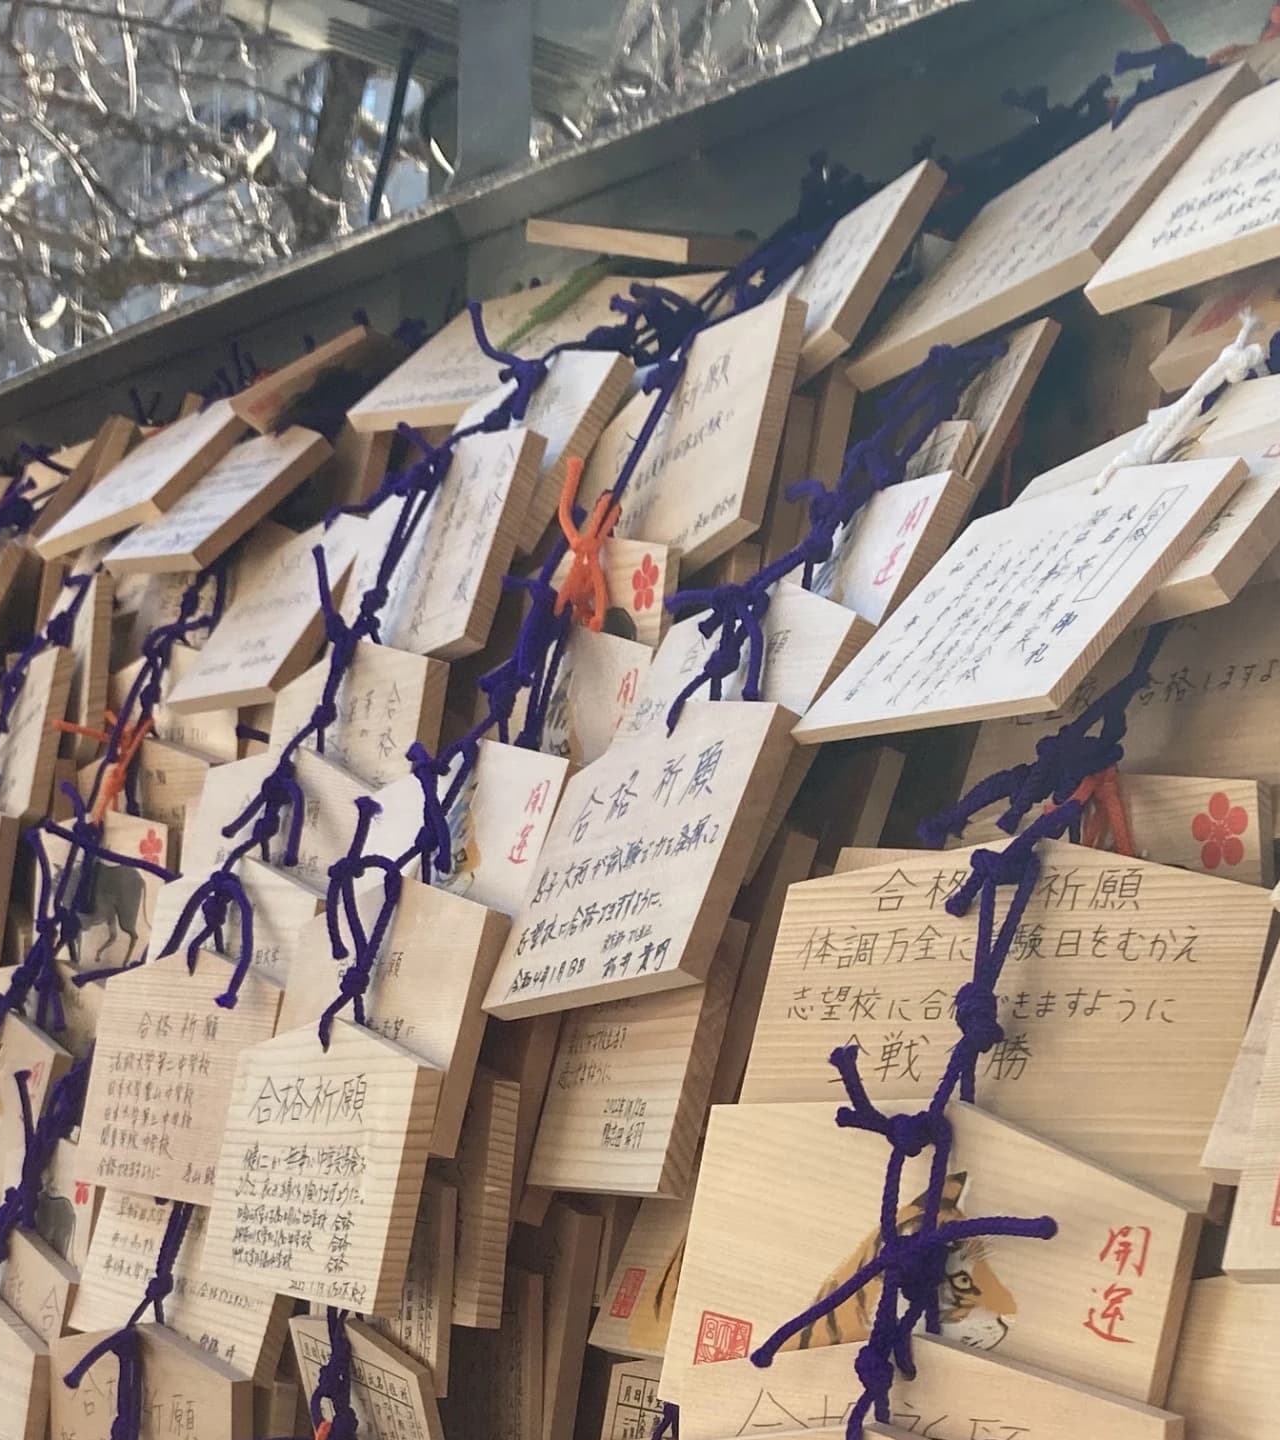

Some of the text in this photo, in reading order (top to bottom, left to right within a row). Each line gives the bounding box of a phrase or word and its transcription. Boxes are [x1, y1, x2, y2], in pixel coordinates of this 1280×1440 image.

[797, 924, 1201, 971] 体調万全に験日をむかえ
[826, 1030, 1035, 1084] 戦勝
[247, 1072, 369, 1126] 合格祈願
[1080, 1224, 1154, 1347] 開運
